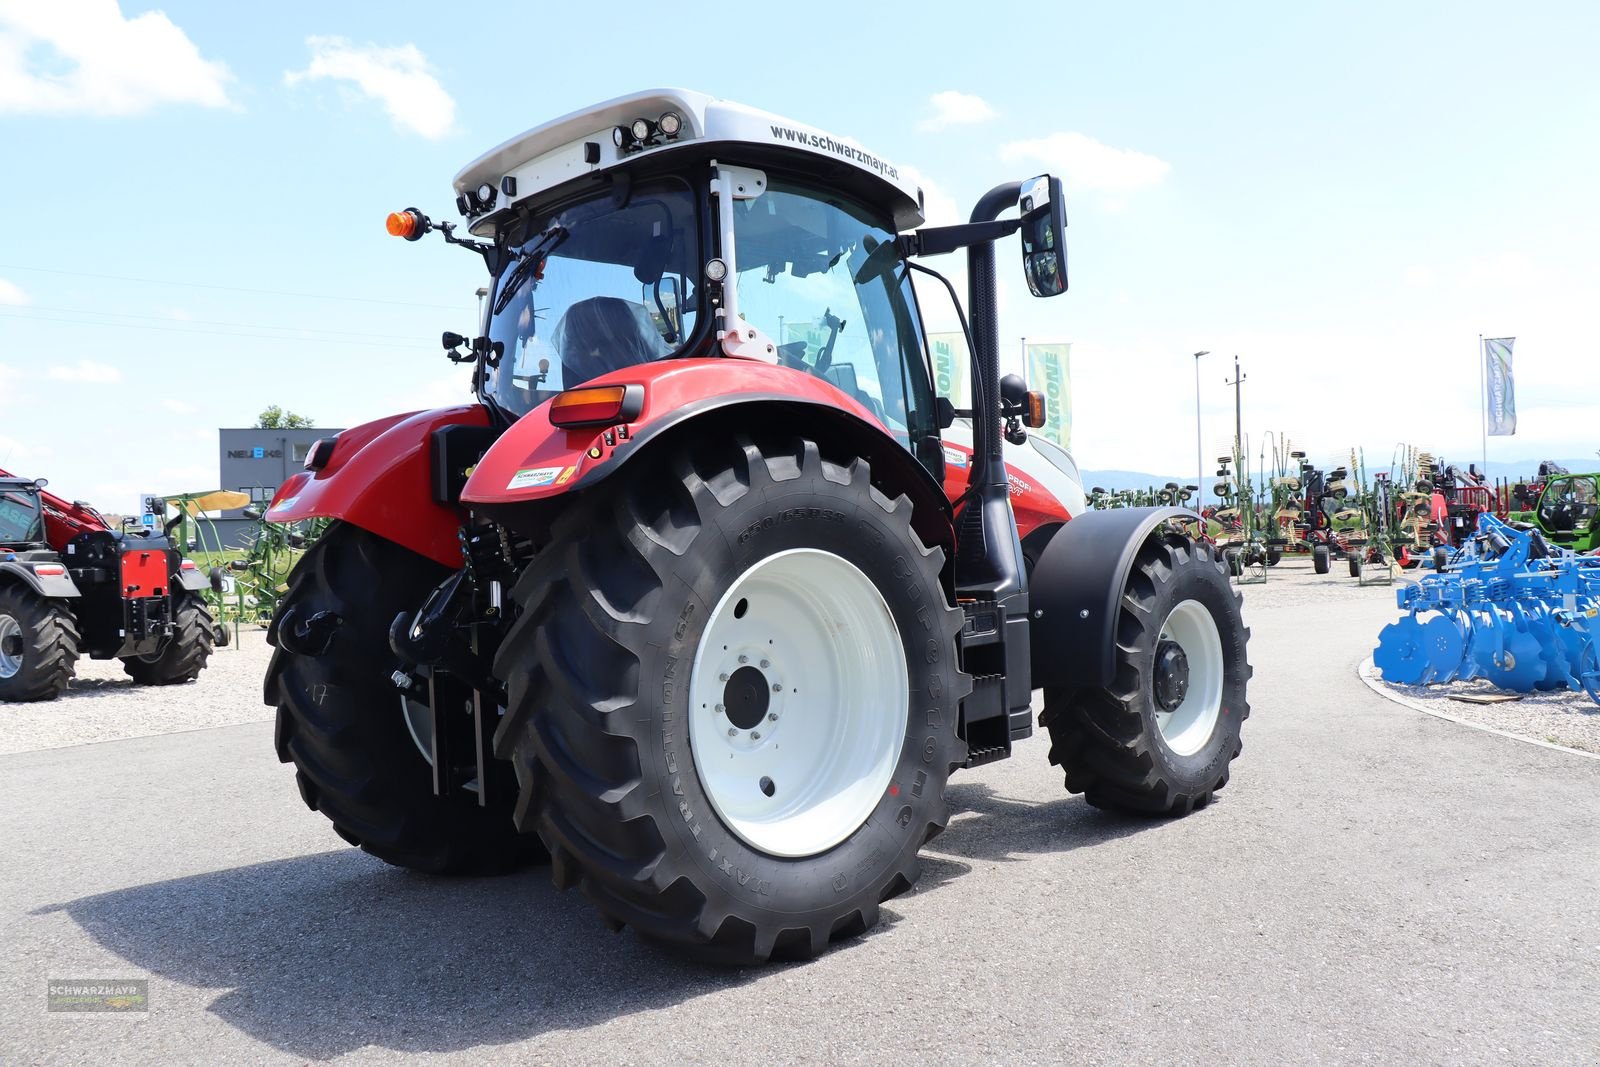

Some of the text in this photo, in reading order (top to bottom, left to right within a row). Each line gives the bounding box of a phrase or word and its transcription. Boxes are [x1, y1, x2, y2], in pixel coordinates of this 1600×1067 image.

[770, 125, 899, 180] www.schwarzmayr.at
[1046, 352, 1061, 431] KRONE
[1008, 473, 1032, 493] PROFI
[0, 504, 32, 528] ASE
